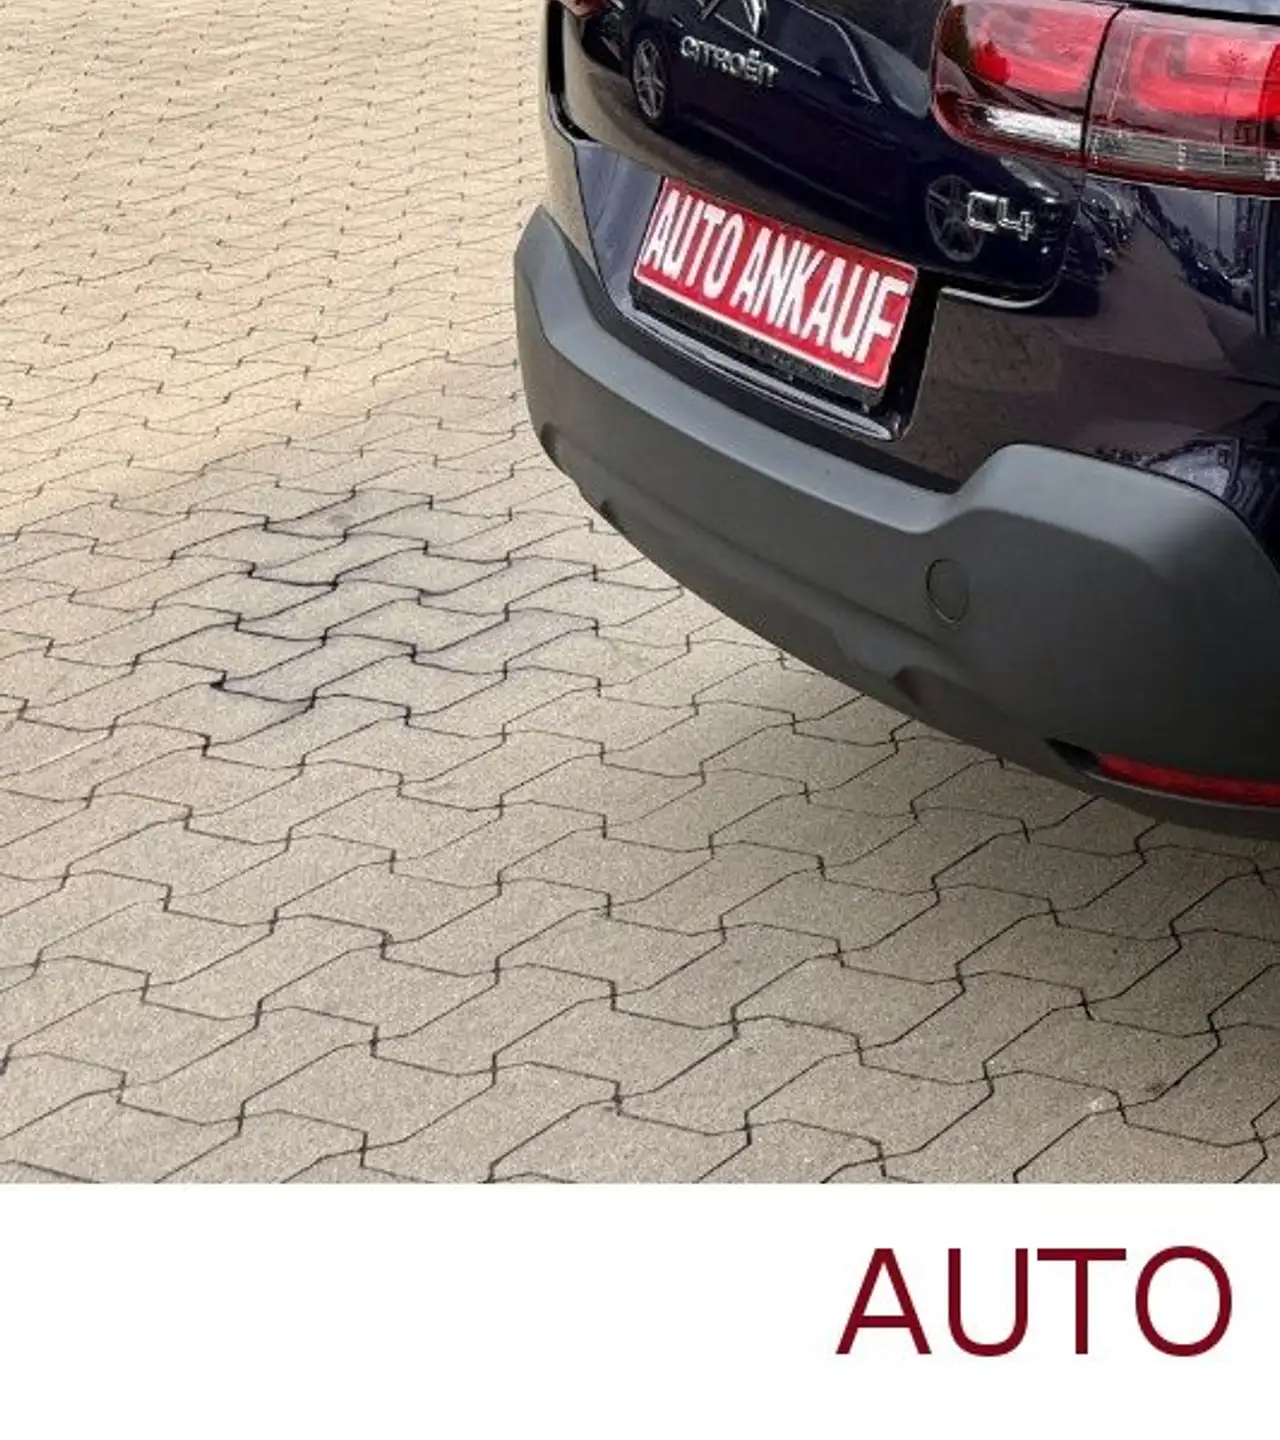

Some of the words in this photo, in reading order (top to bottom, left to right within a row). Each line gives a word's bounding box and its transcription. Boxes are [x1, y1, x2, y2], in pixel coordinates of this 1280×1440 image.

[966, 189, 1035, 242] C4
[642, 188, 745, 300] AUTO
[729, 226, 909, 364] ANKAUF
